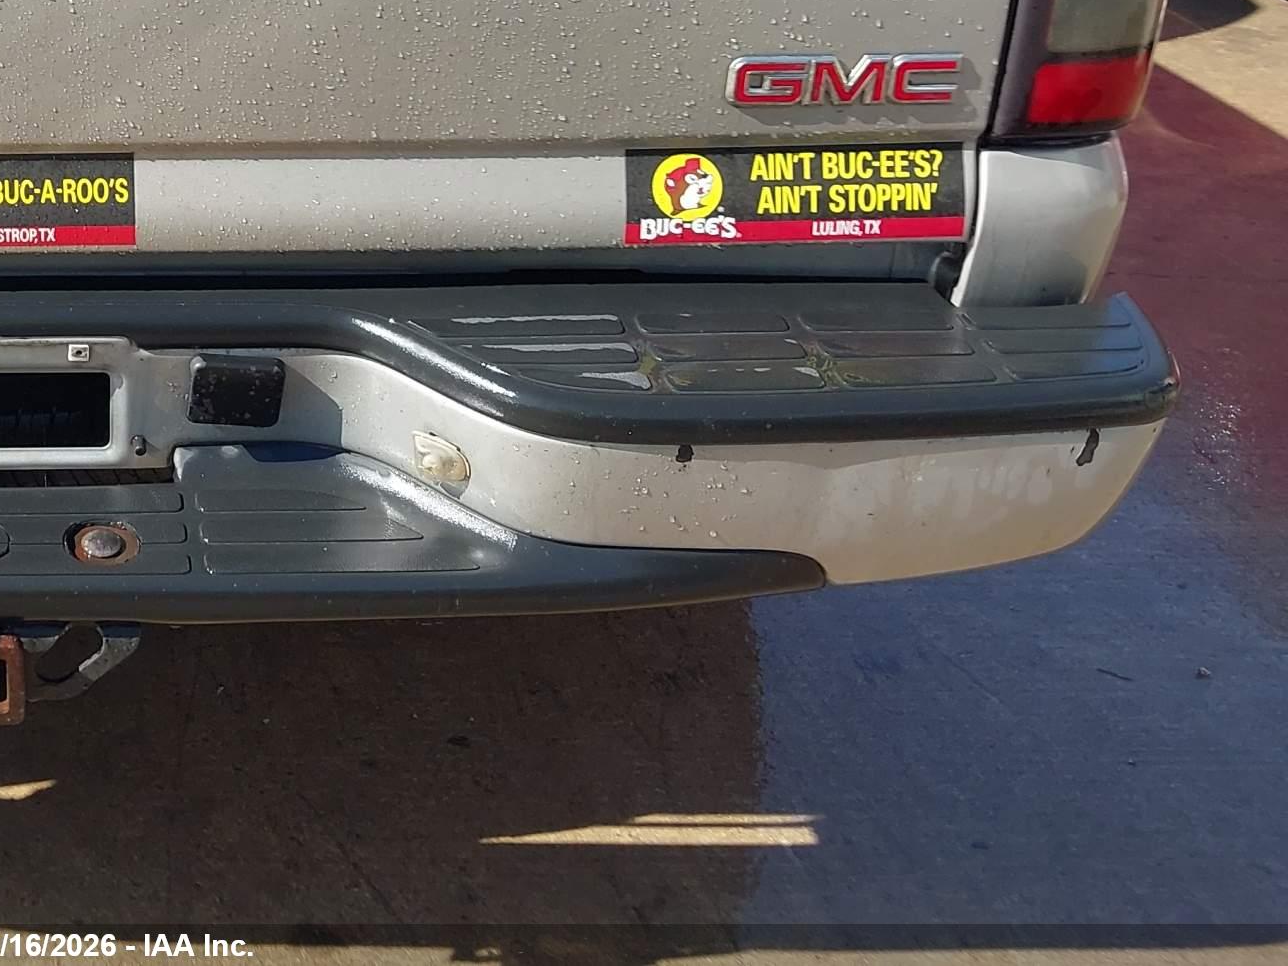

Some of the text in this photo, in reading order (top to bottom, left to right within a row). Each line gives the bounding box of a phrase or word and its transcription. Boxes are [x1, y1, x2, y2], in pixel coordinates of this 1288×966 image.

[725, 54, 964, 106] GMC
[750, 149, 944, 181] AIN'T BUC-EE'S?
[757, 183, 938, 214] AIN'T STOPPIN'
